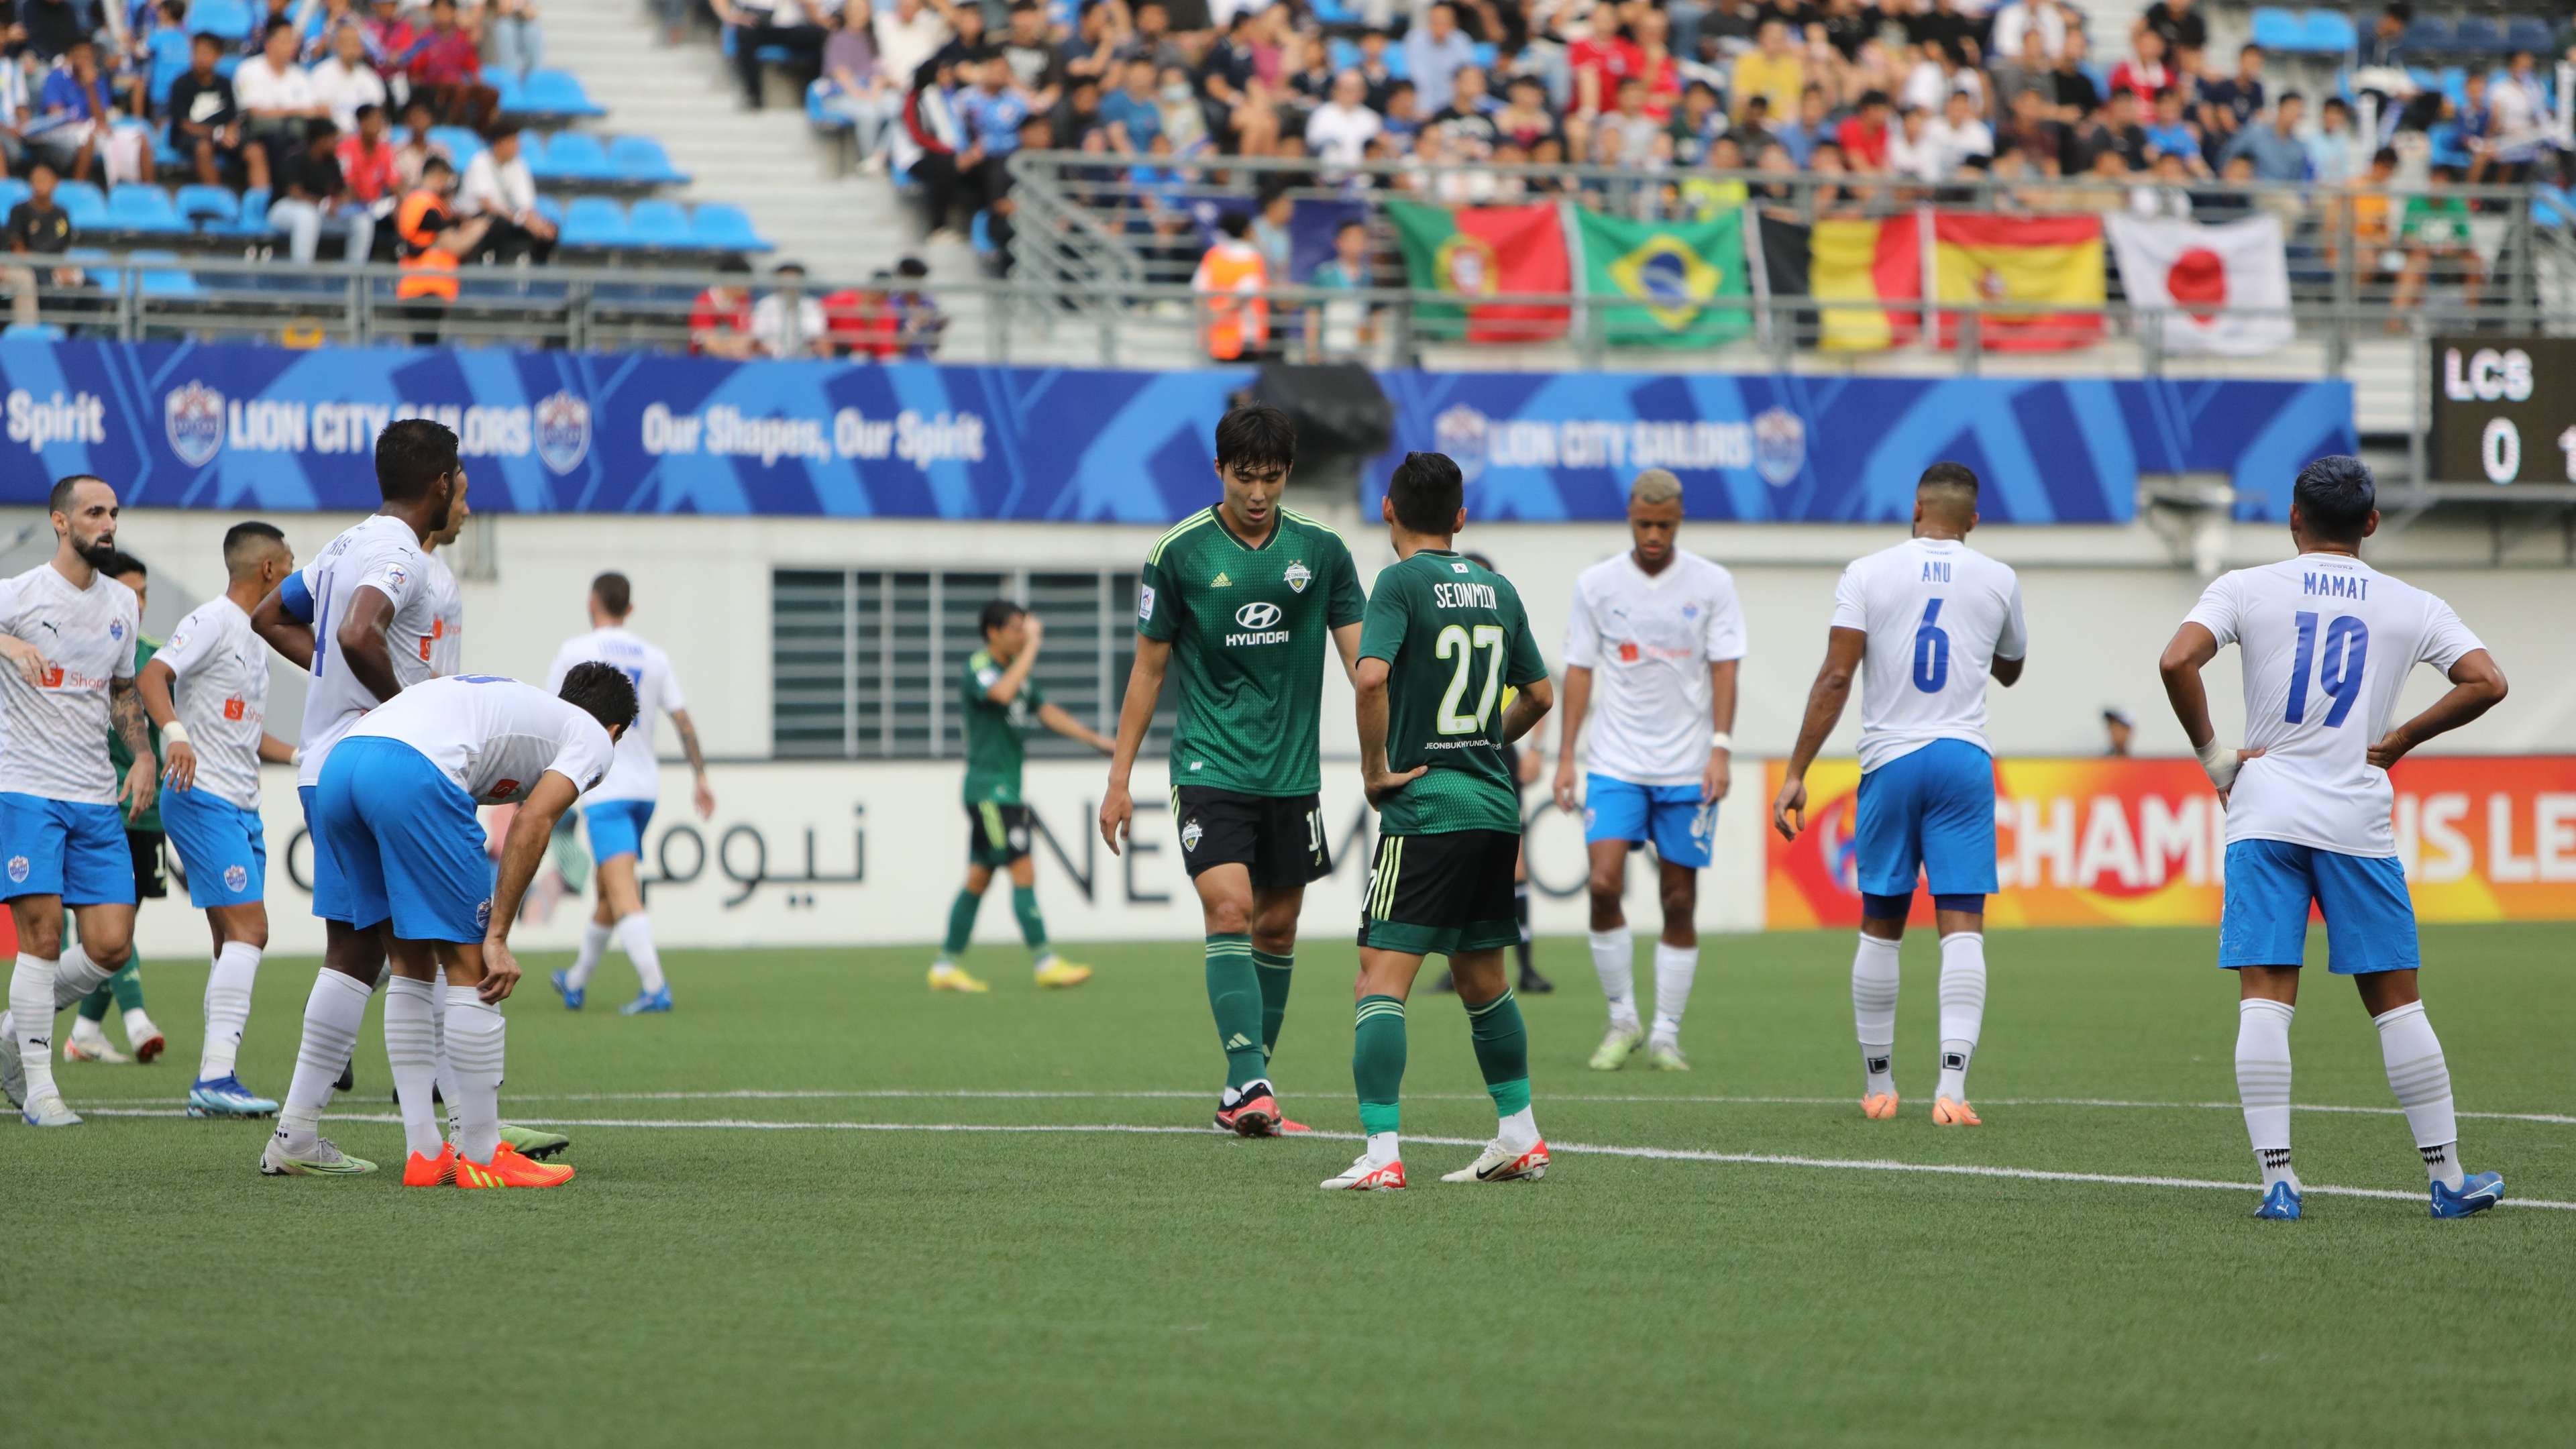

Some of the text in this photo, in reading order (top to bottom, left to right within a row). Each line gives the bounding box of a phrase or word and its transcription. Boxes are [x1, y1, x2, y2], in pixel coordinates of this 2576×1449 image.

[2445, 347, 2534, 402] LCS
[6, 388, 106, 453] Spirit
[228, 400, 307, 452] LION
[311, 401, 390, 453] CITY
[642, 403, 983, 468] Our Shapes, Our Spirit
[1488, 419, 1753, 470] LION CITY SAILORS
[2483, 416, 2520, 485] 0
[1434, 582, 1497, 610] SEONMIN
[1921, 561, 1951, 582] ANU
[2304, 572, 2369, 601] MAMAT
[1226, 631, 1289, 647] HYUNDAI
[1913, 598, 1949, 694] 6
[1436, 625, 1504, 735] 27
[2284, 611, 2369, 729] 19
